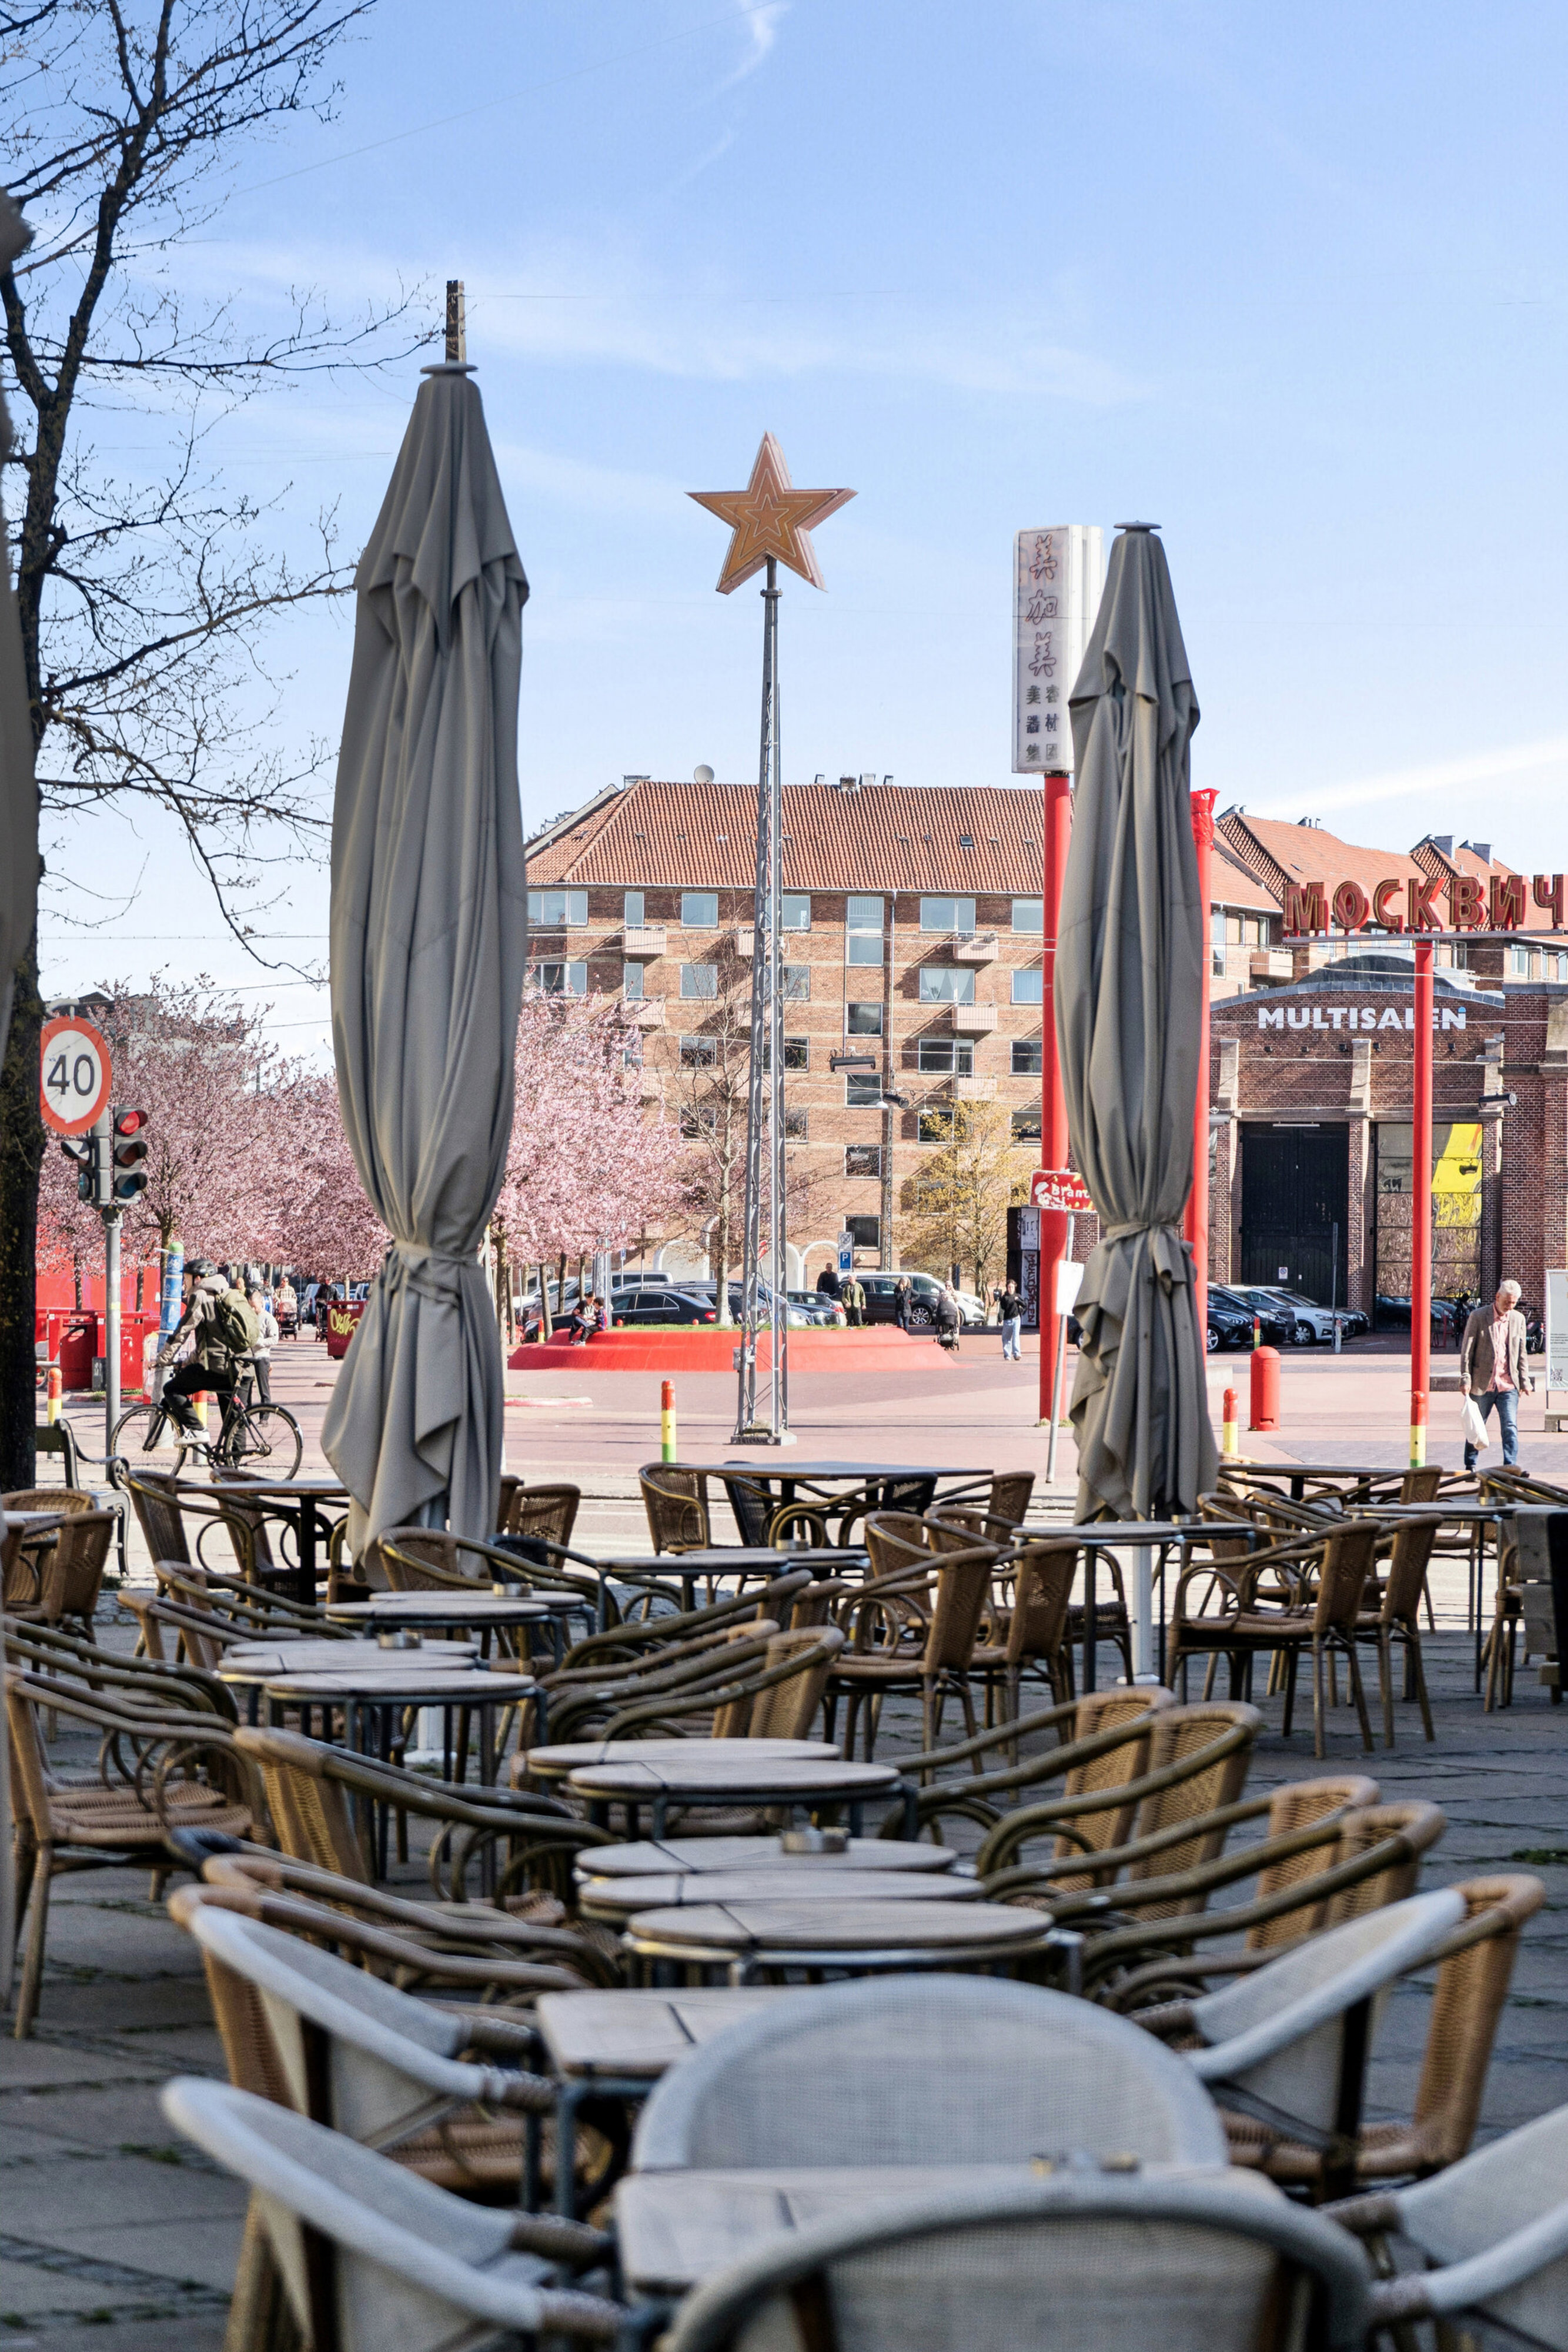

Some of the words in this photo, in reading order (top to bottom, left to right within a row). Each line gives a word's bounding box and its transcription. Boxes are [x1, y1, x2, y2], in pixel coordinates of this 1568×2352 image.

[1283, 873, 1565, 931] МОСКВИЧ
[47, 1054, 94, 1096] 40
[842, 1253, 848, 1261] P
